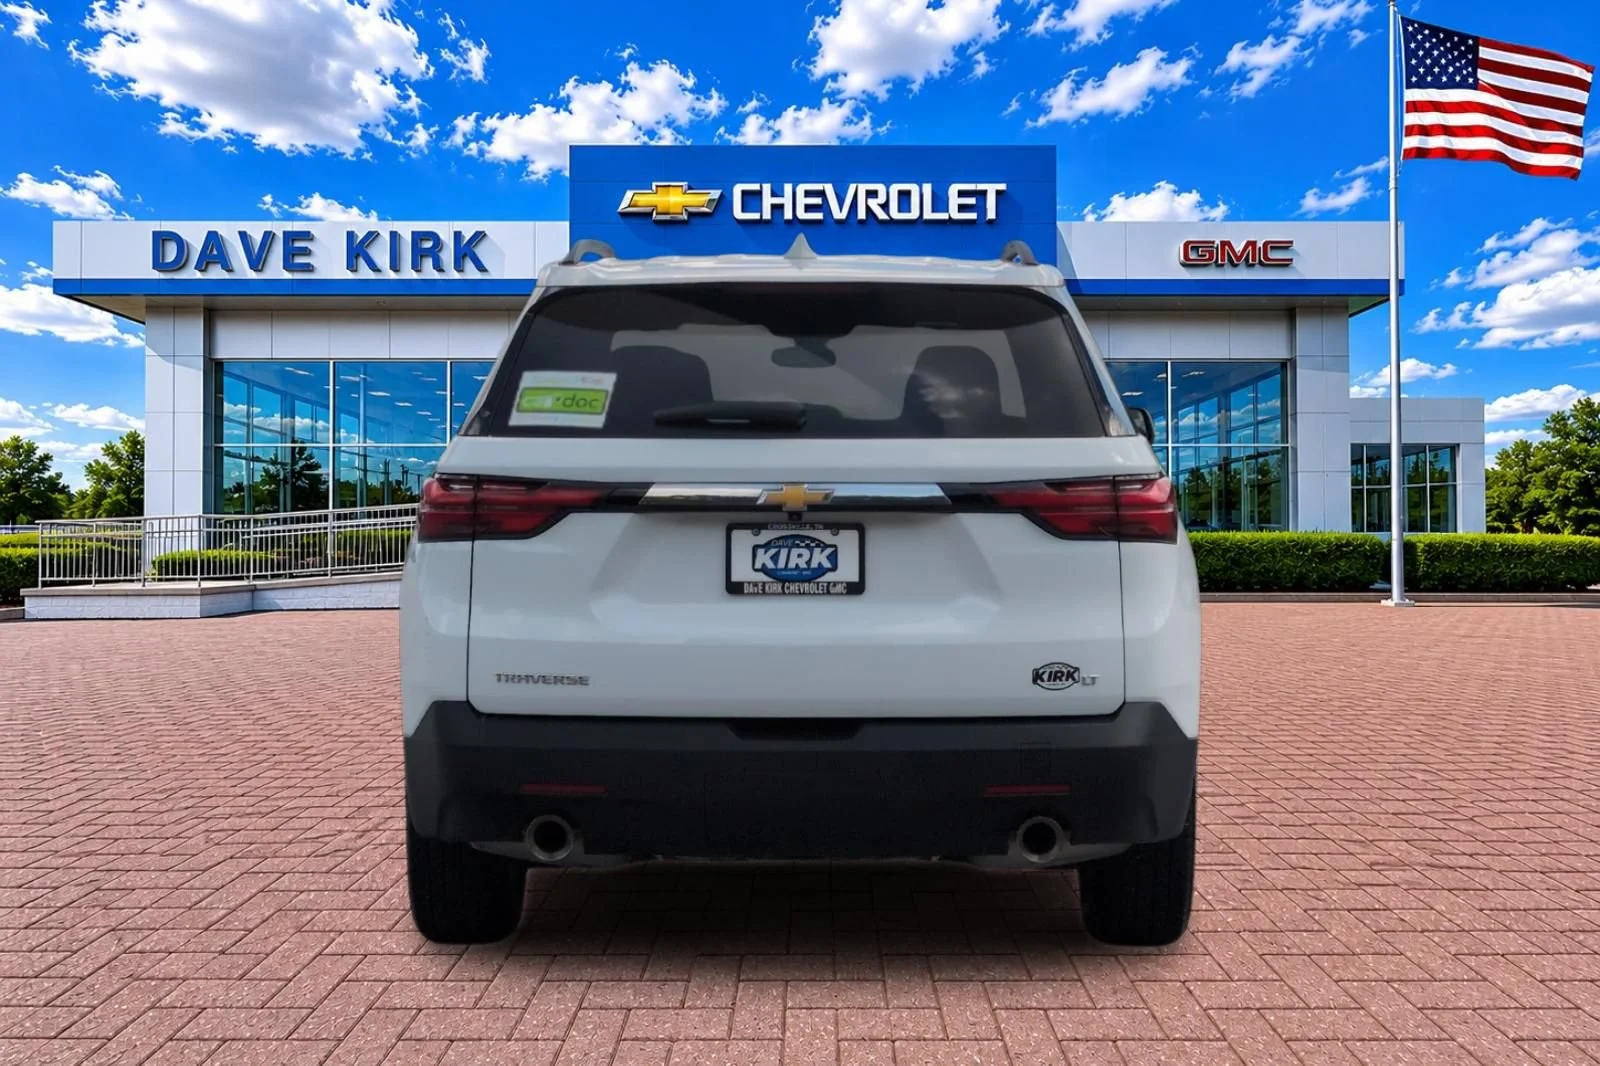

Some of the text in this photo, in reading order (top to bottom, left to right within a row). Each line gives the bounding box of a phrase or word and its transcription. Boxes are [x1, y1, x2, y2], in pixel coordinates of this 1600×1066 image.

[732, 183, 1007, 221] CHEVROLET
[152, 230, 489, 273] DAVE KIRK
[1180, 240, 1294, 267] GMC
[770, 538, 793, 547] DAVE
[754, 547, 836, 569] KIRK
[743, 583, 848, 594] DAVE KIRK CHEVROLET GMC
[495, 673, 590, 686] TRAVERSE
[1034, 669, 1078, 683] KIRK
[1081, 674, 1100, 686] LT
